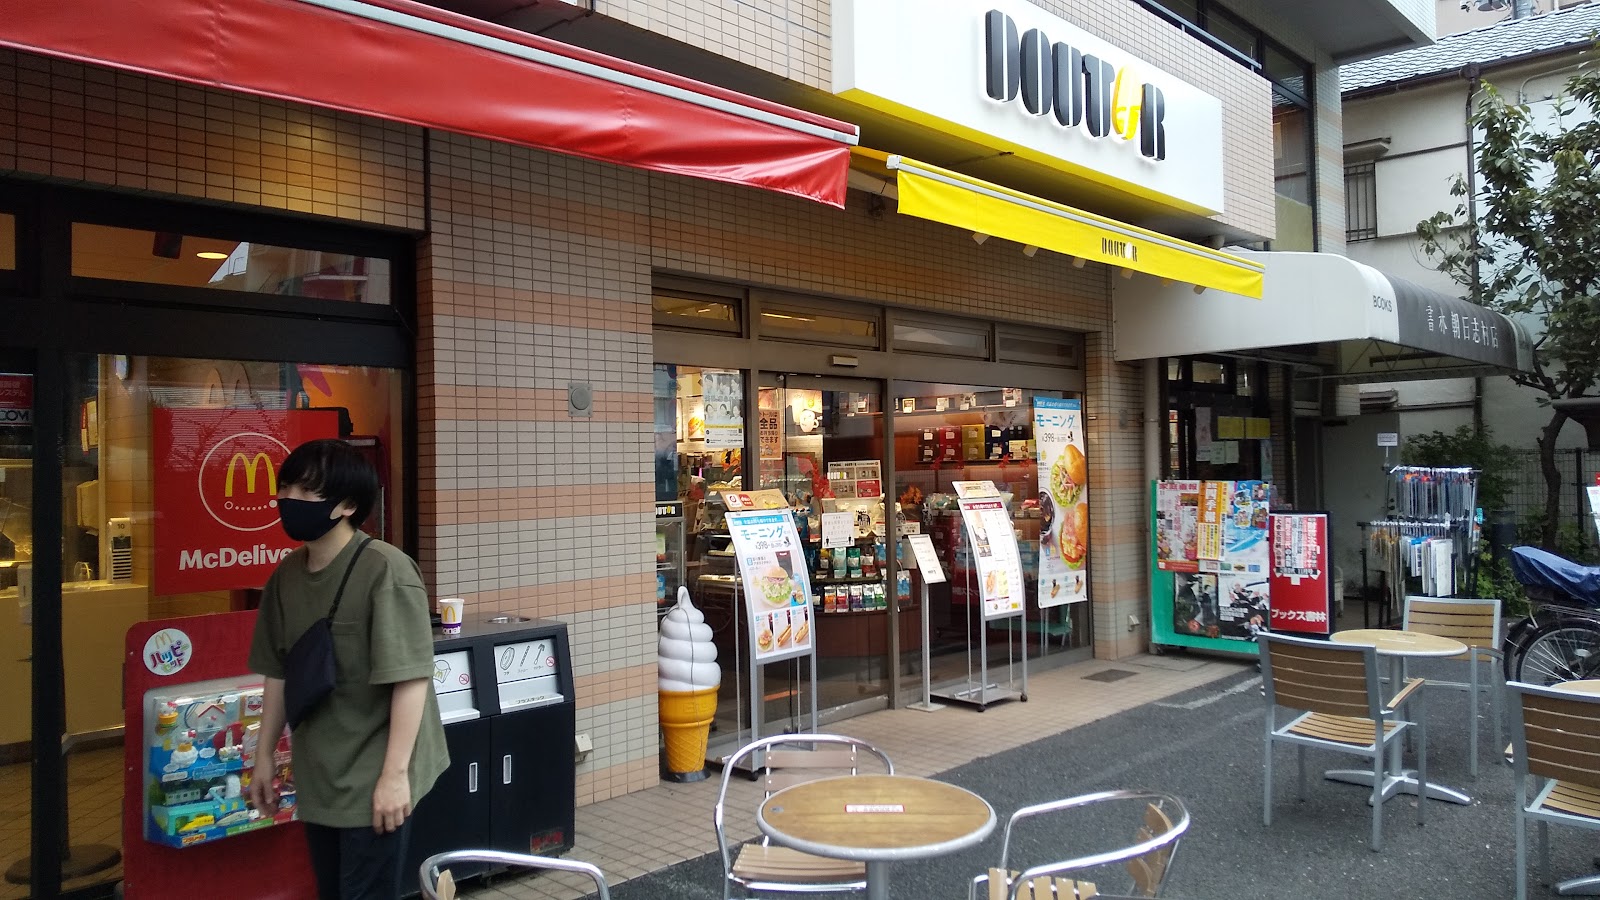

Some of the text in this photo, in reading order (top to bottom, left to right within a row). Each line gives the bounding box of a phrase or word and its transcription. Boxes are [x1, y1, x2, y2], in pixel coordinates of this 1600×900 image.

[985, 9, 1166, 162] DOUTOR
[1102, 237, 1138, 262] DOUTOR
[1373, 295, 1393, 313] BOOKS
[760, 418, 778, 430] 全品
[1036, 414, 1076, 429] モーニング
[741, 526, 784, 541] モーニング
[150, 640, 190, 668] ハッピー
